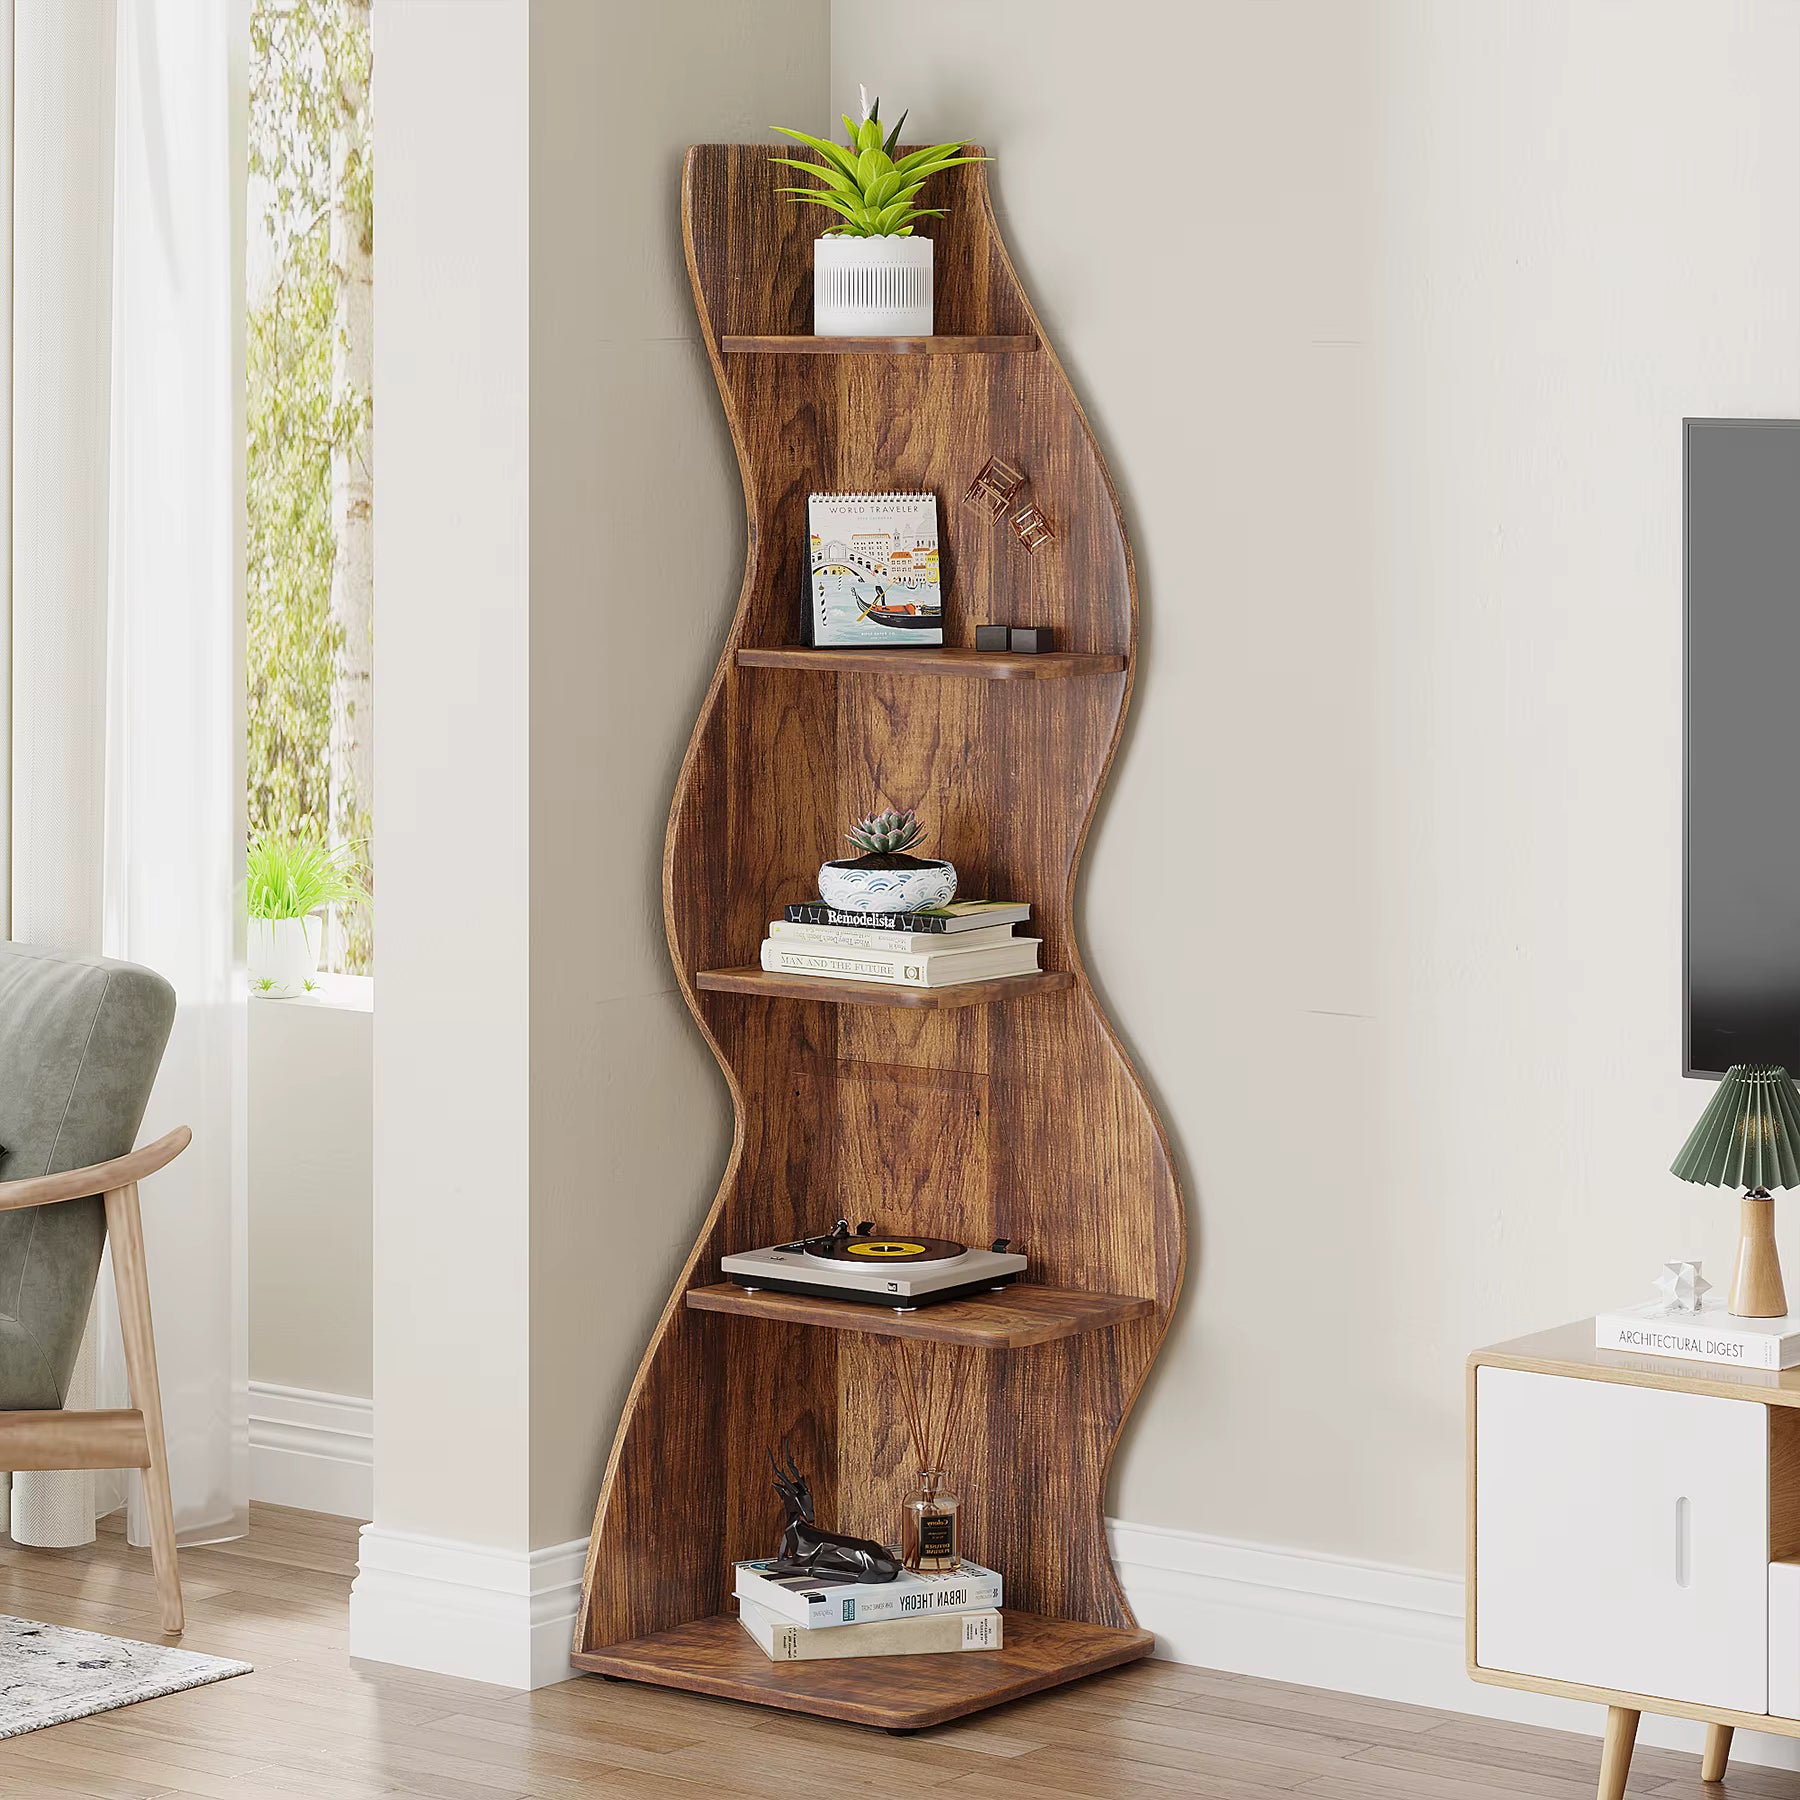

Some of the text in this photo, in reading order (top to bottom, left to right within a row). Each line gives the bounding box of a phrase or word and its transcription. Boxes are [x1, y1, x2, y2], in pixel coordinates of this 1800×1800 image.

[829, 506, 865, 514] WORLD
[827, 910, 896, 928] Remodelista
[781, 955, 803, 965] MAN
[807, 958, 828, 968] AND
[830, 960, 852, 970] THE
[855, 962, 894, 975] FUTURE
[1619, 1330, 1703, 1353] ARCHITECTURAL
[1706, 1340, 1744, 1358] DIGEST
